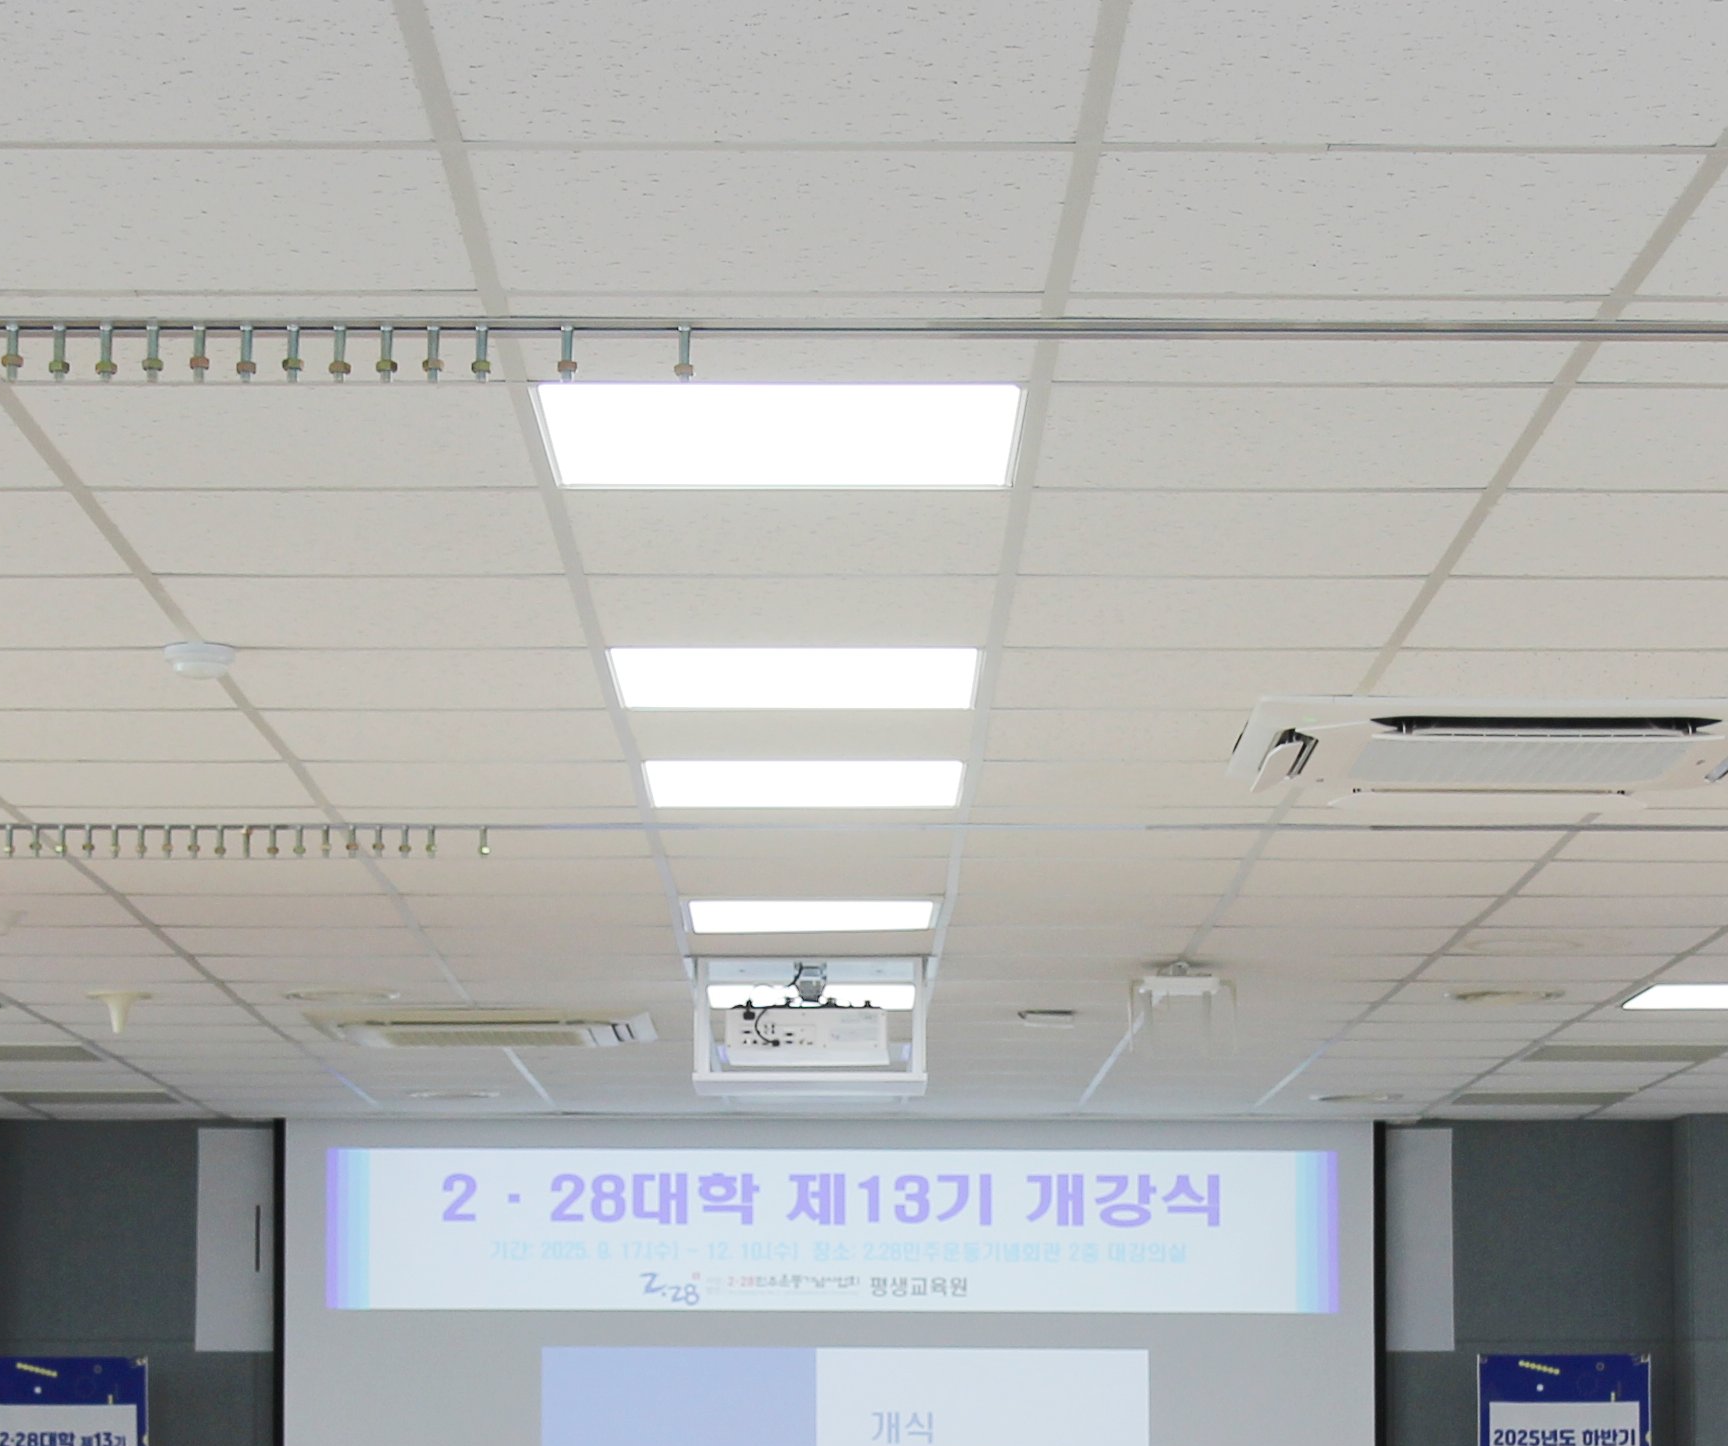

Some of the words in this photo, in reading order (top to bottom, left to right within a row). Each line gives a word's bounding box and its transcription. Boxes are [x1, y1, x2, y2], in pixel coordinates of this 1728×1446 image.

[442, 1172, 478, 1222] 2
[550, 1172, 761, 1226] 28대학
[785, 1172, 993, 1227] 제13기
[1026, 1173, 1221, 1229] 개강식
[870, 1276, 968, 1298] 평생교육원
[871, 1411, 934, 1445] 개식
